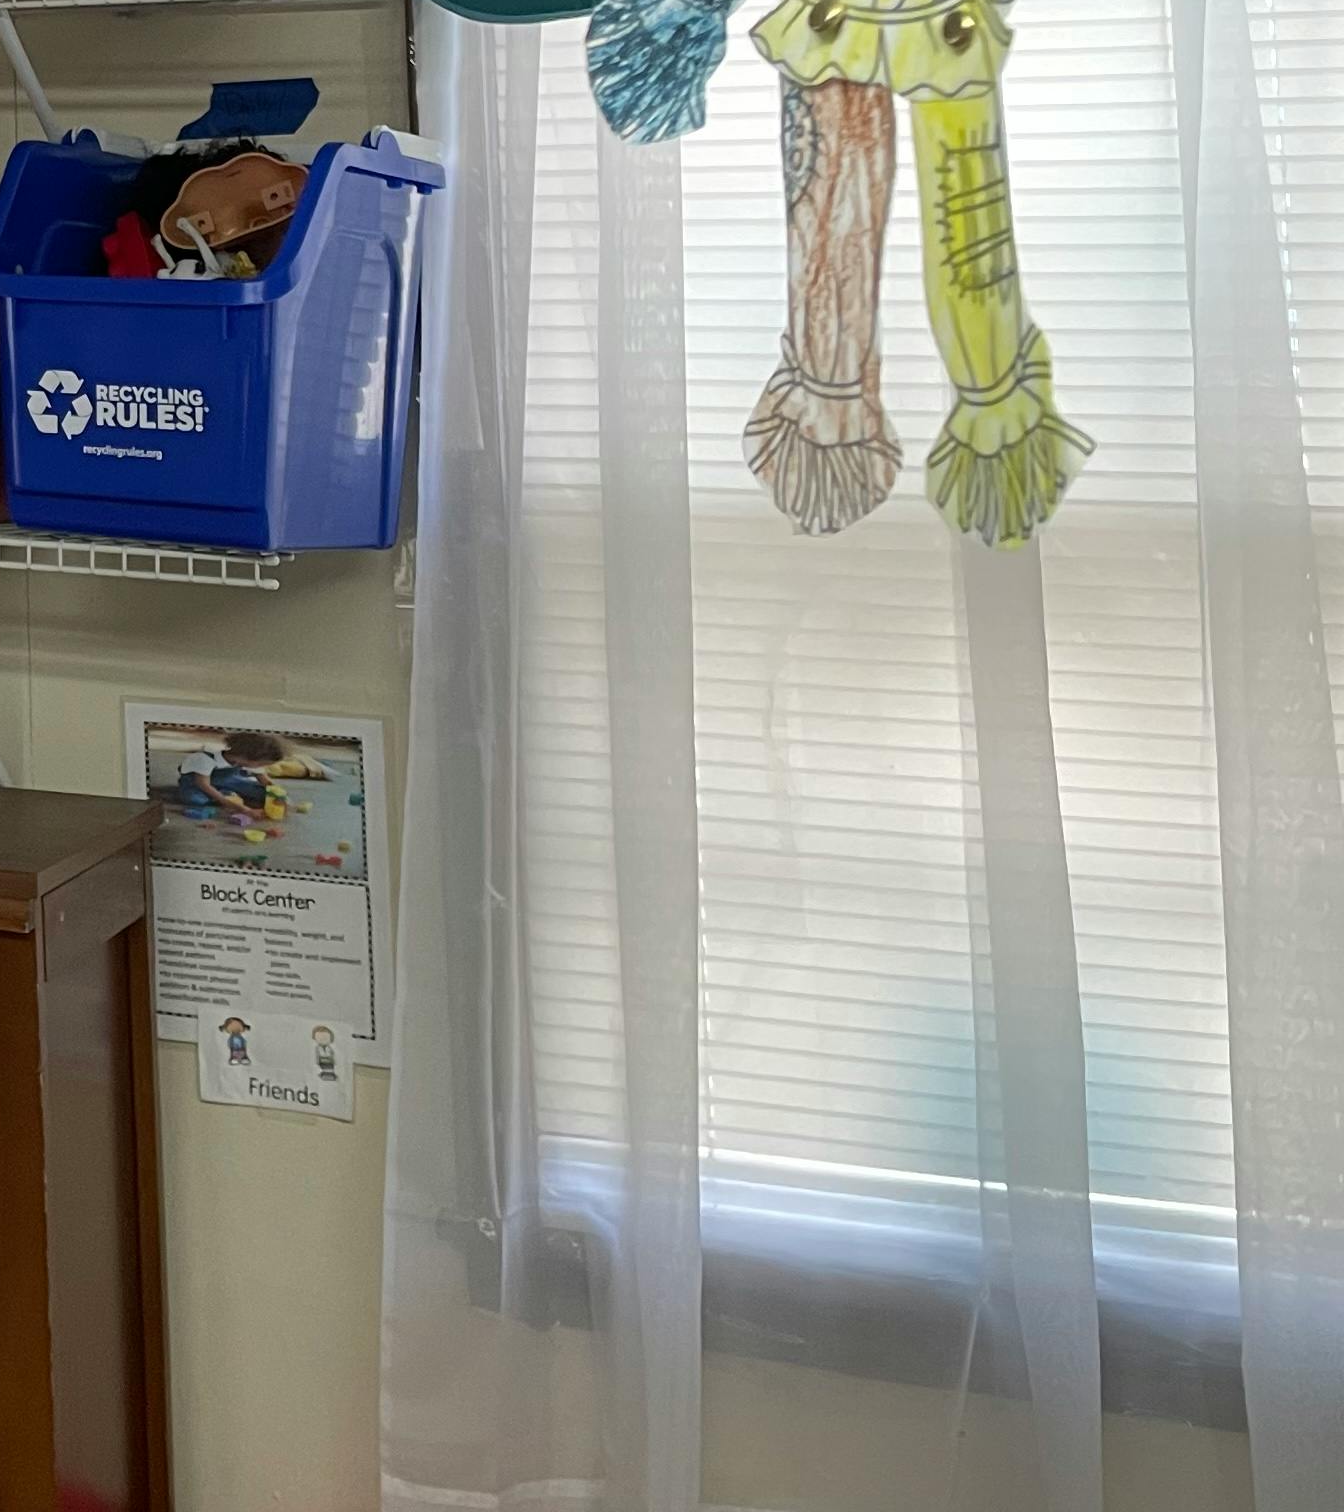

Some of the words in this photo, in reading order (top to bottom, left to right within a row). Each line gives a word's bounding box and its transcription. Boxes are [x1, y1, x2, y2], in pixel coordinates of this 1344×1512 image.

[96, 384, 204, 406] RECYCLING
[96, 401, 204, 432] RULES!
[200, 884, 248, 904] Block
[253, 889, 316, 910] Center
[249, 1076, 320, 1106] Friends
